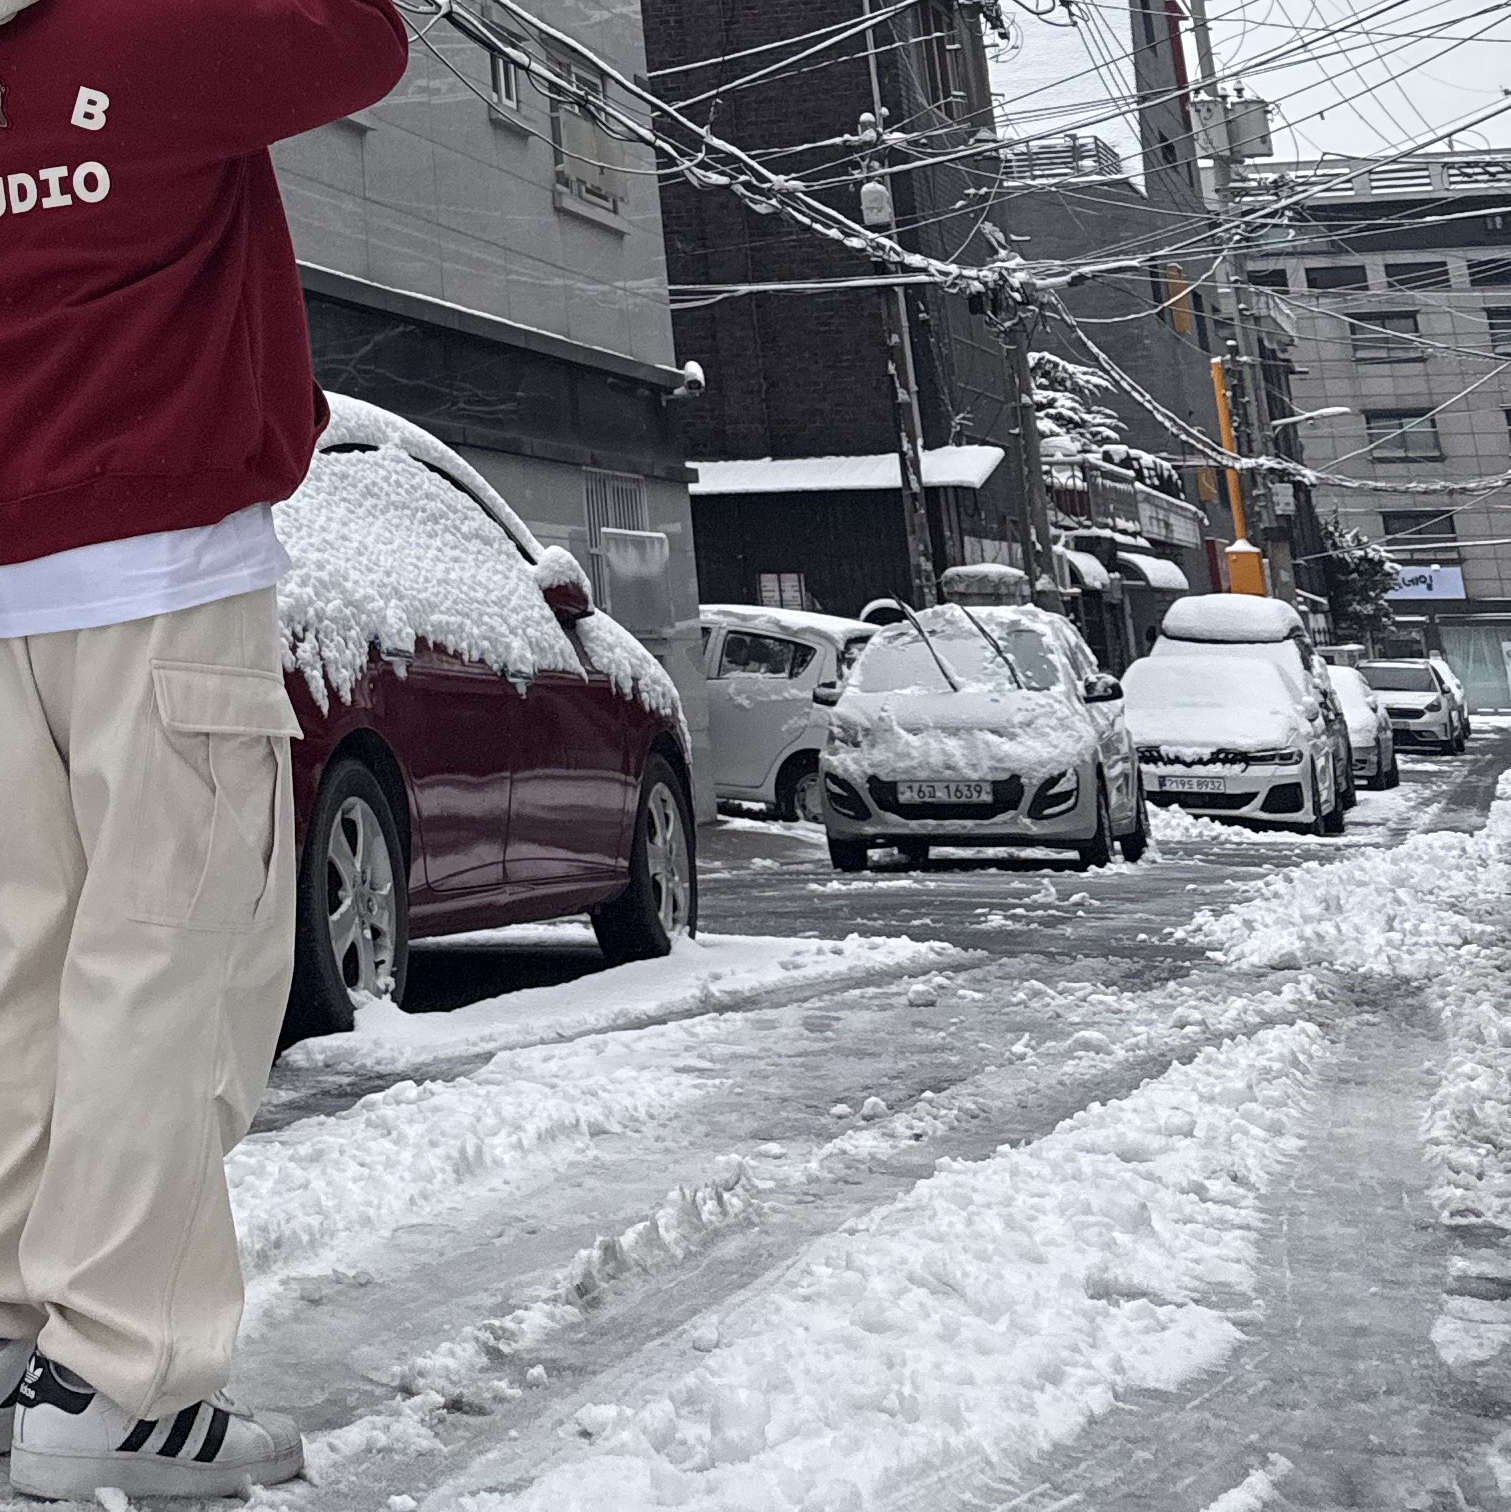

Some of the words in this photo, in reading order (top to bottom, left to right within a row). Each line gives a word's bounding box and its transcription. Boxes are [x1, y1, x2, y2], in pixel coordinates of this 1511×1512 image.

[70, 85, 110, 131] B
[1394, 574, 1433, 591] 네일
[943, 784, 983, 799] 1639
